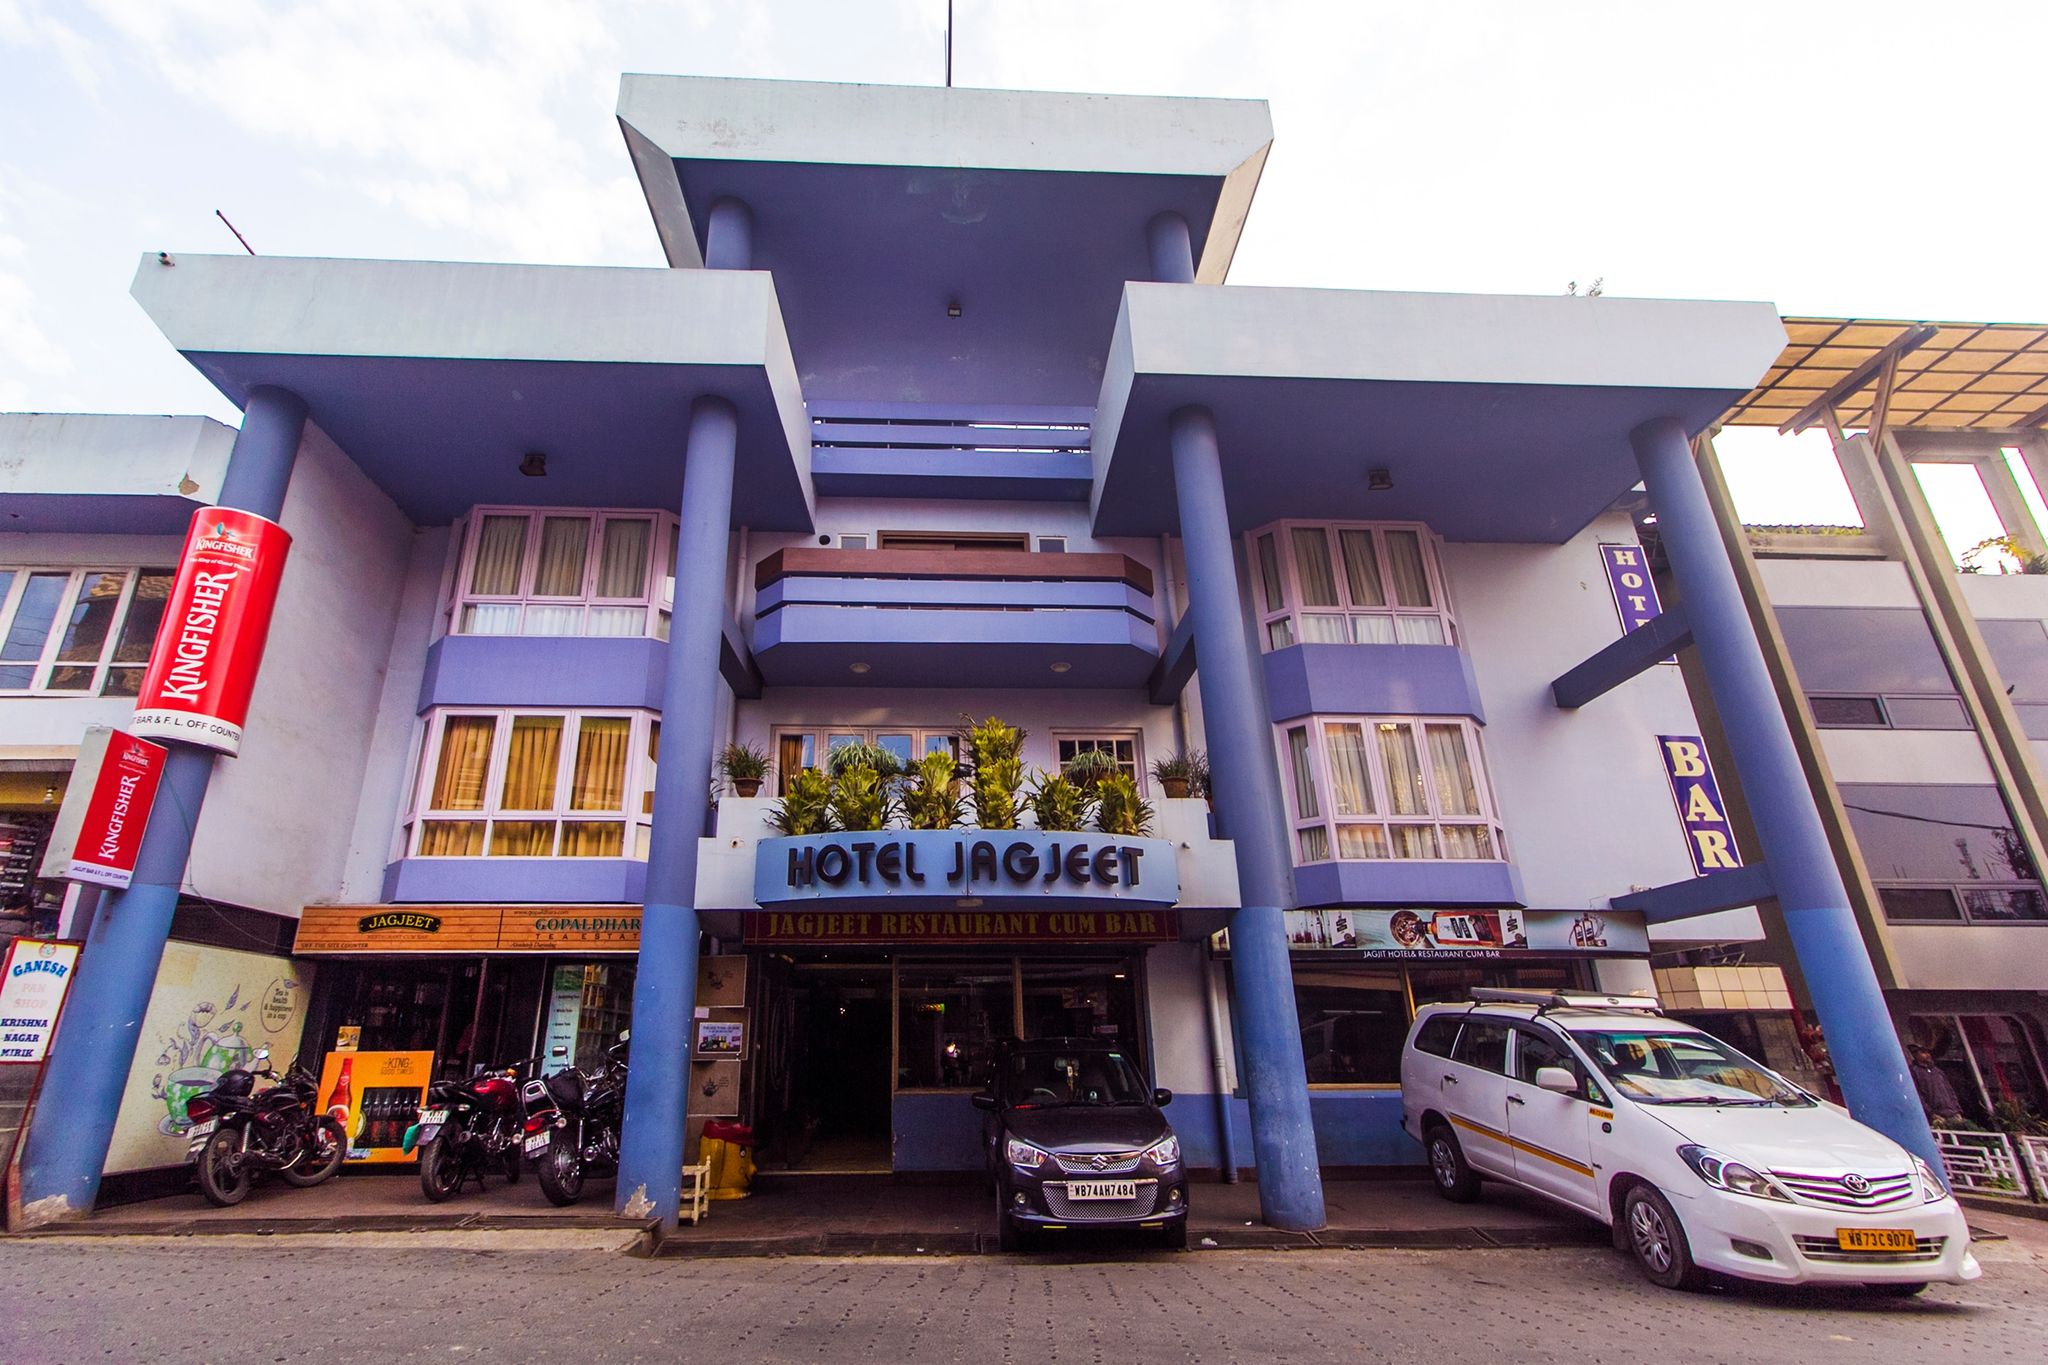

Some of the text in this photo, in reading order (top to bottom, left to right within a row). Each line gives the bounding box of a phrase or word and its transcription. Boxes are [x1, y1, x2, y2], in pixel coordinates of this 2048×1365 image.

[195, 538, 254, 559] KINGFISHER
[160, 571, 238, 704] KINGFISHER
[136, 715, 153, 725] BAR
[154, 715, 161, 724] &
[187, 719, 209, 730] OFF
[1665, 741, 1739, 868] BAR
[98, 775, 141, 861] KINGFISHER
[787, 841, 1145, 887] HOTEL JAGJEET
[368, 914, 434, 929] JAGJEET
[767, 911, 1157, 938] JAGJEET RESTAURANT CUM BAR
[1418, 950, 1464, 958] RESTAURANT
[1465, 950, 1484, 958] CUM
[1486, 950, 1501, 958] BAR
[12, 960, 68, 978] GANESH
[14, 998, 48, 1009] SHOP
[0, 1018, 48, 1028] KRISHNA
[3, 1033, 40, 1043] NAGAR
[0, 1048, 34, 1057] MIRIK
[1074, 1184, 1134, 1197] WB74AH7484
